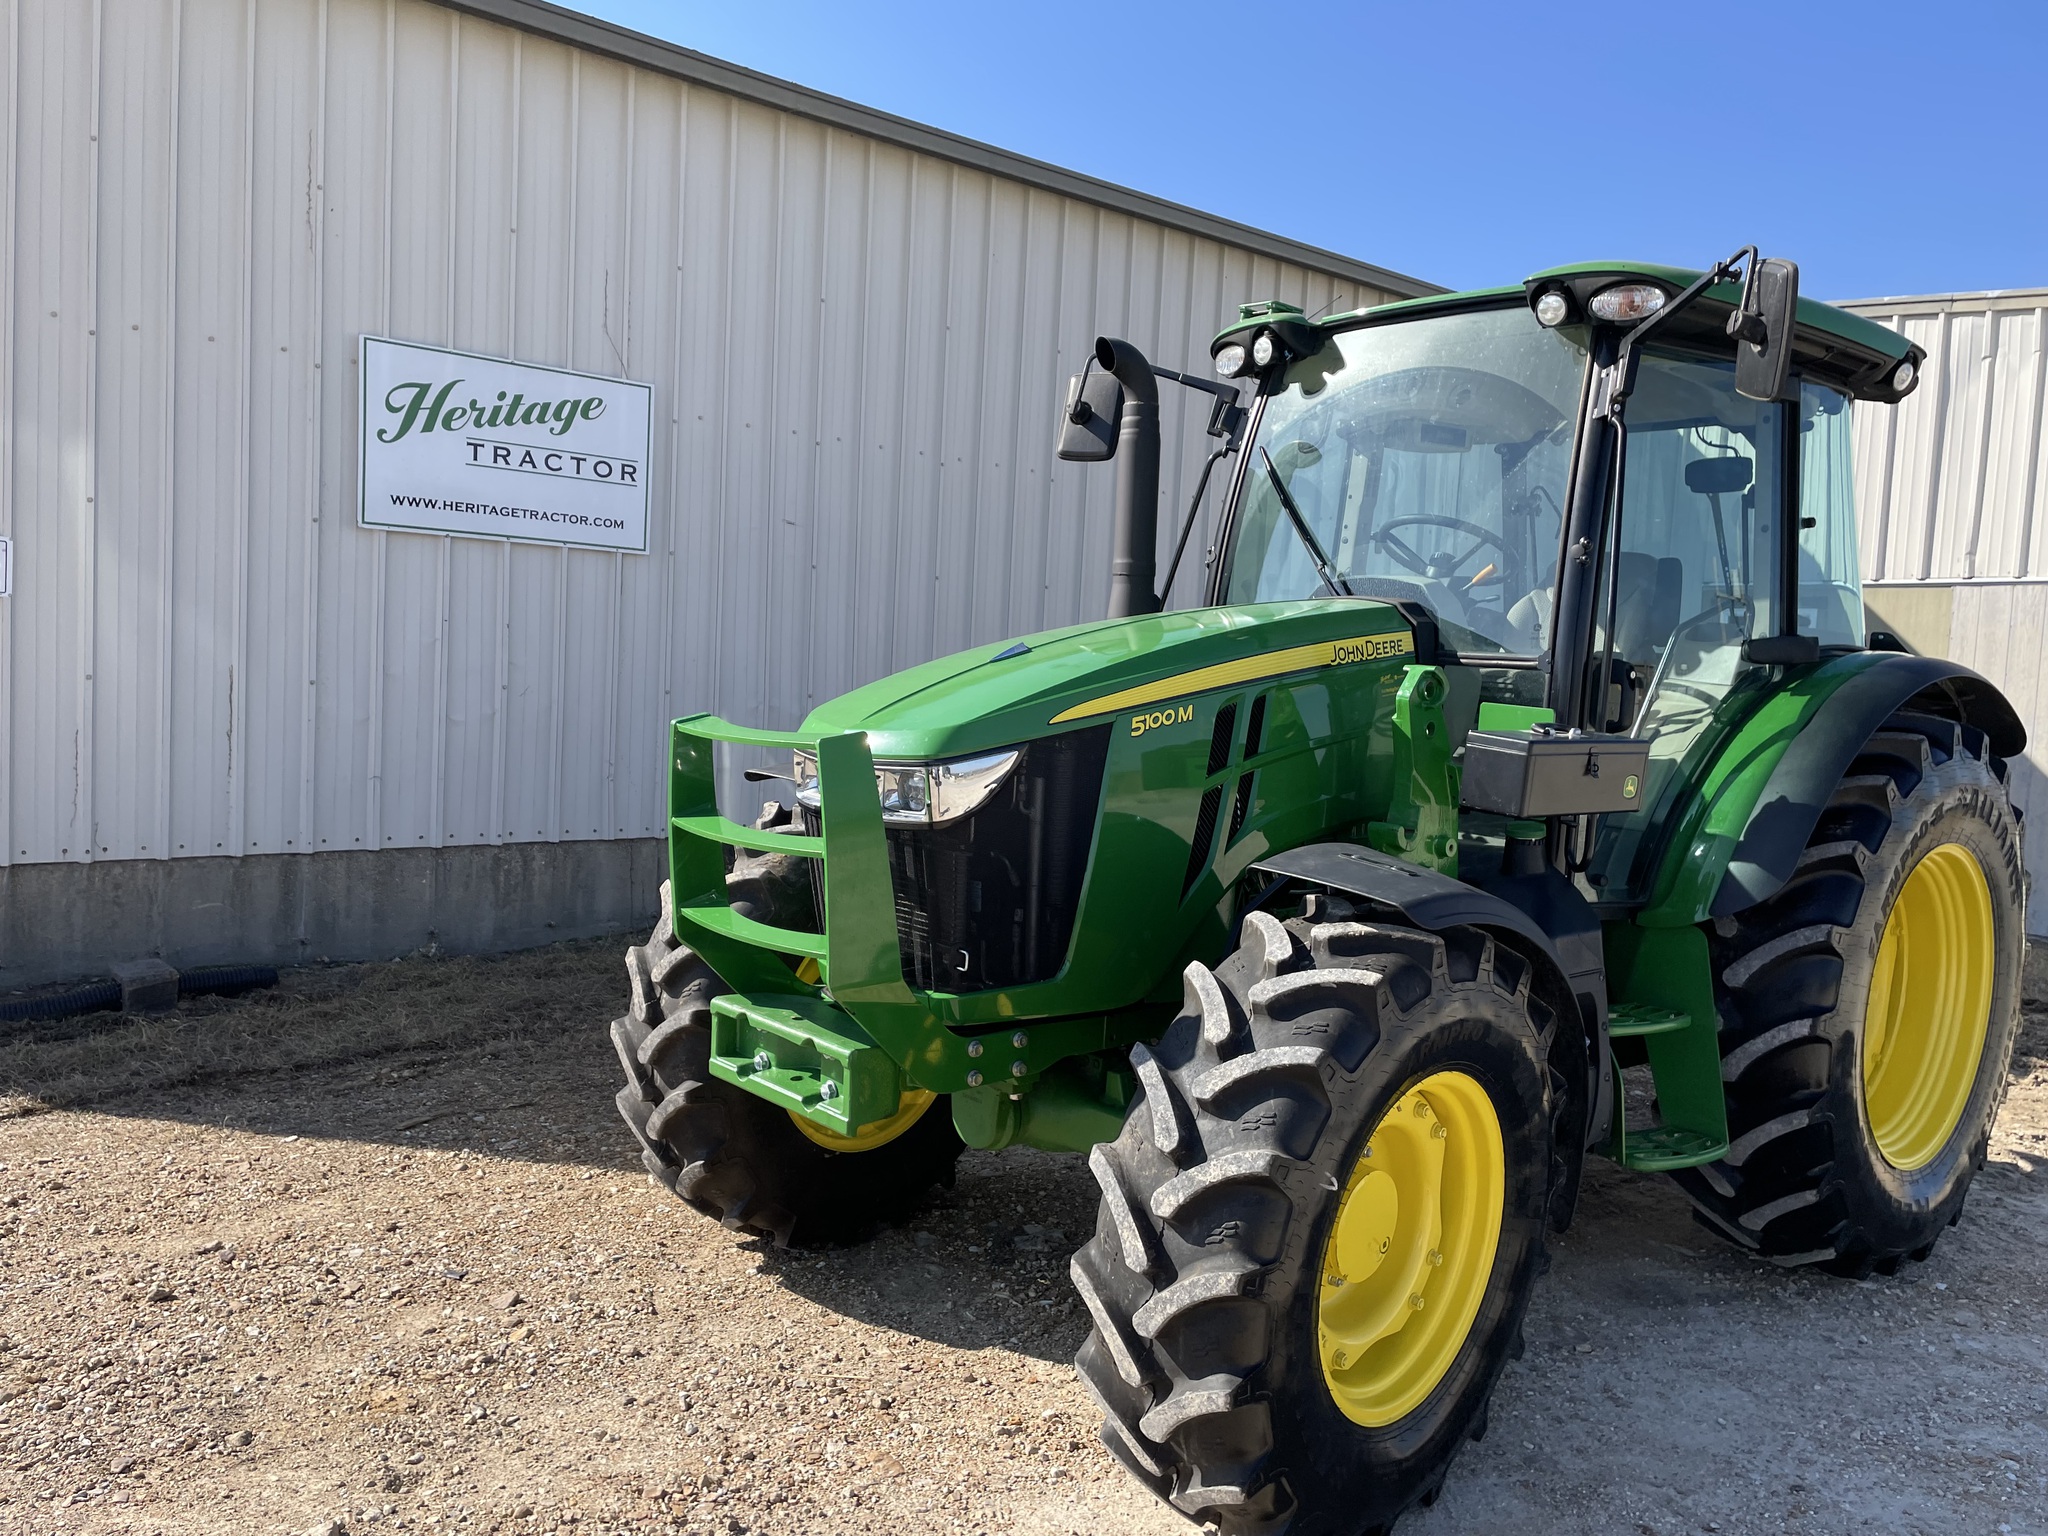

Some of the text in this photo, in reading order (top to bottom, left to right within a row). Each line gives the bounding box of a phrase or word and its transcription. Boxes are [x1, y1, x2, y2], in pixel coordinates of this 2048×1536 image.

[376, 379, 607, 443] Heritage
[466, 441, 638, 483] TRACTOR
[389, 494, 625, 530] WWW.HERITAGETRACTOR.COM
[1330, 639, 1404, 664] JOHN DEERE
[1130, 703, 1194, 737] 5100 M
